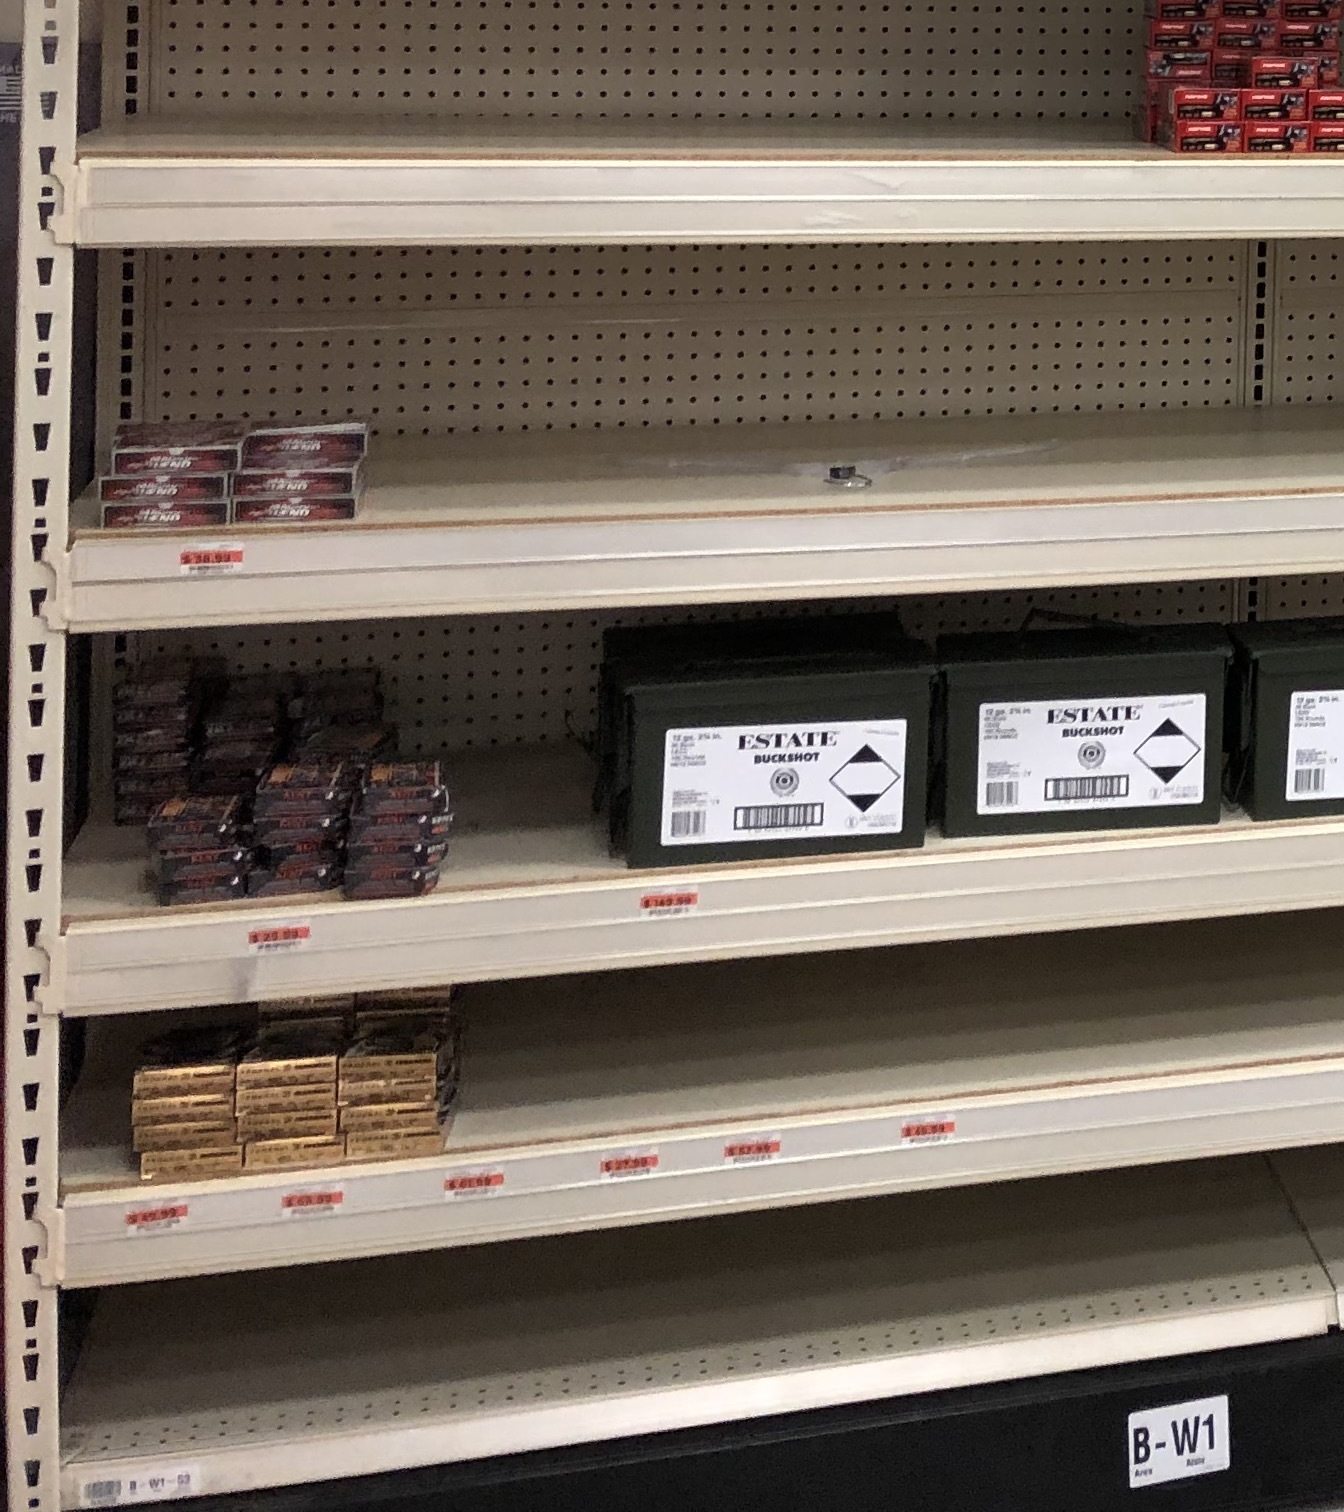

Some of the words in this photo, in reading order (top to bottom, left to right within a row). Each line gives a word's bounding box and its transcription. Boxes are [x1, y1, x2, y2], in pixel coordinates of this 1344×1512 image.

[1047, 705, 1140, 724] ESTATE
[1062, 726, 1124, 737] BUCKSHOT
[738, 731, 839, 751] ESTATE
[754, 752, 820, 764] BUCKSHOT
